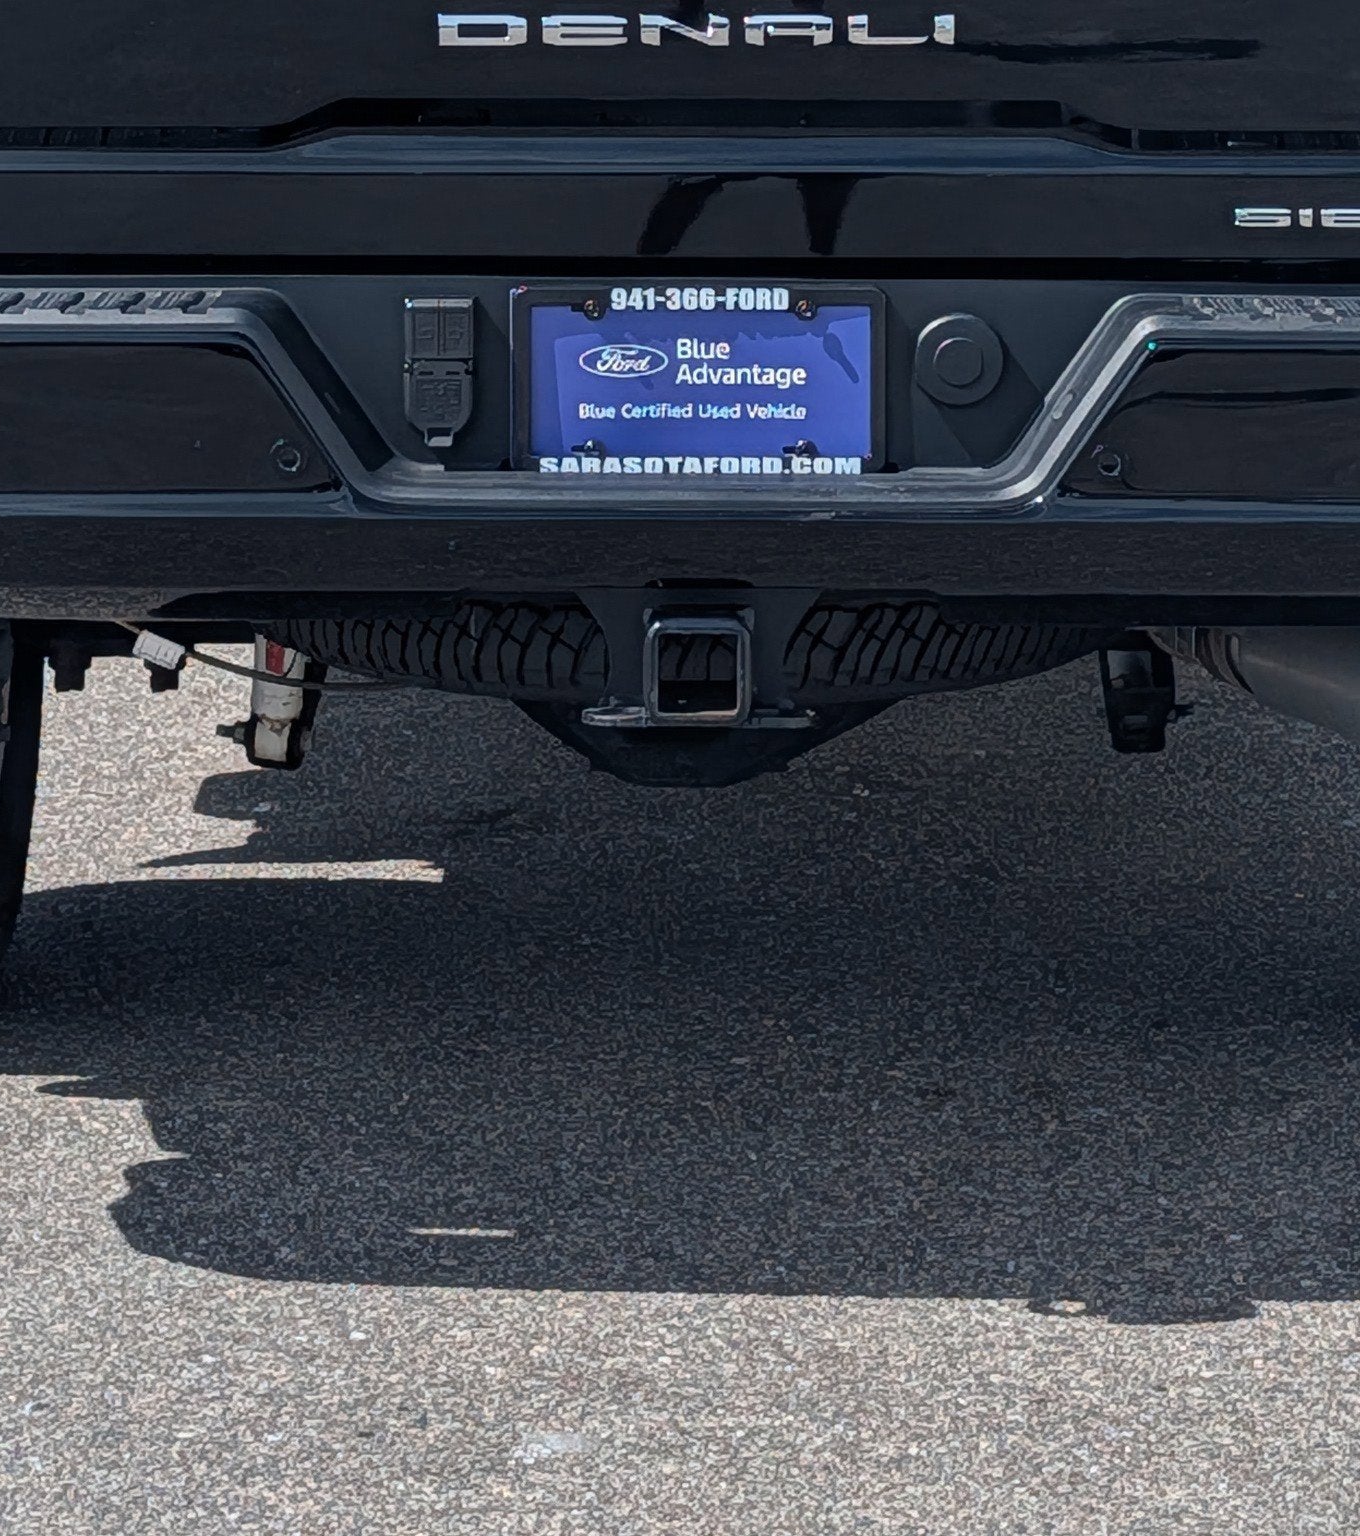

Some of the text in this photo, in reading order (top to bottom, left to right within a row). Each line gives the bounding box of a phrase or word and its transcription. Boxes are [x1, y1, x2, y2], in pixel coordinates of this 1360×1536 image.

[438, 13, 955, 46] DENALI
[610, 287, 789, 311] 941-366-FORD
[596, 348, 652, 372] Ford
[676, 338, 730, 360] Blue
[675, 362, 807, 389] Advantage
[579, 403, 807, 420] Blue Certified Used Vehicle
[539, 456, 861, 475] SARASOTAFORD.COM
